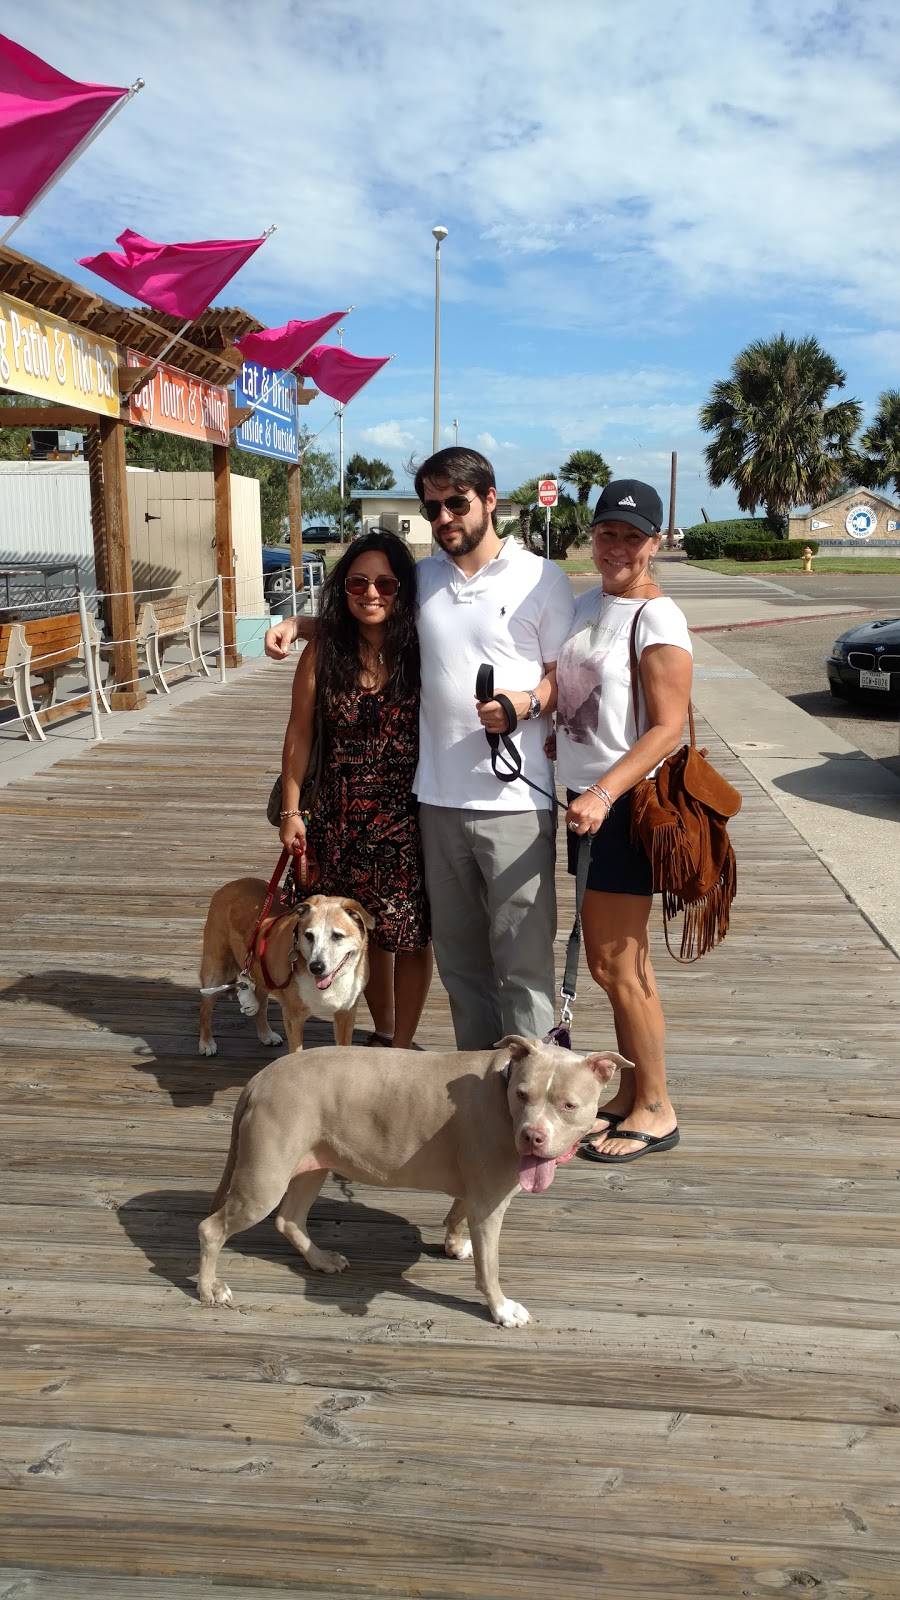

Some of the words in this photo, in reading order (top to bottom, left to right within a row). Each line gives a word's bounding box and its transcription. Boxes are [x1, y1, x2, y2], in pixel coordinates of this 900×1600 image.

[9, 309, 50, 378] Patio
[54, 327, 66, 385] &
[68, 332, 93, 393] Tiki
[96, 343, 115, 399] Bar
[157, 366, 185, 423] Tours
[188, 379, 197, 425] &
[199, 382, 227, 443] Sailing
[242, 362, 259, 400] Eat
[261, 366, 270, 403] &
[272, 372, 295, 416] Drink
[241, 415, 263, 445] Inside
[265, 418, 272, 447] &
[273, 421, 296, 454] Outside
